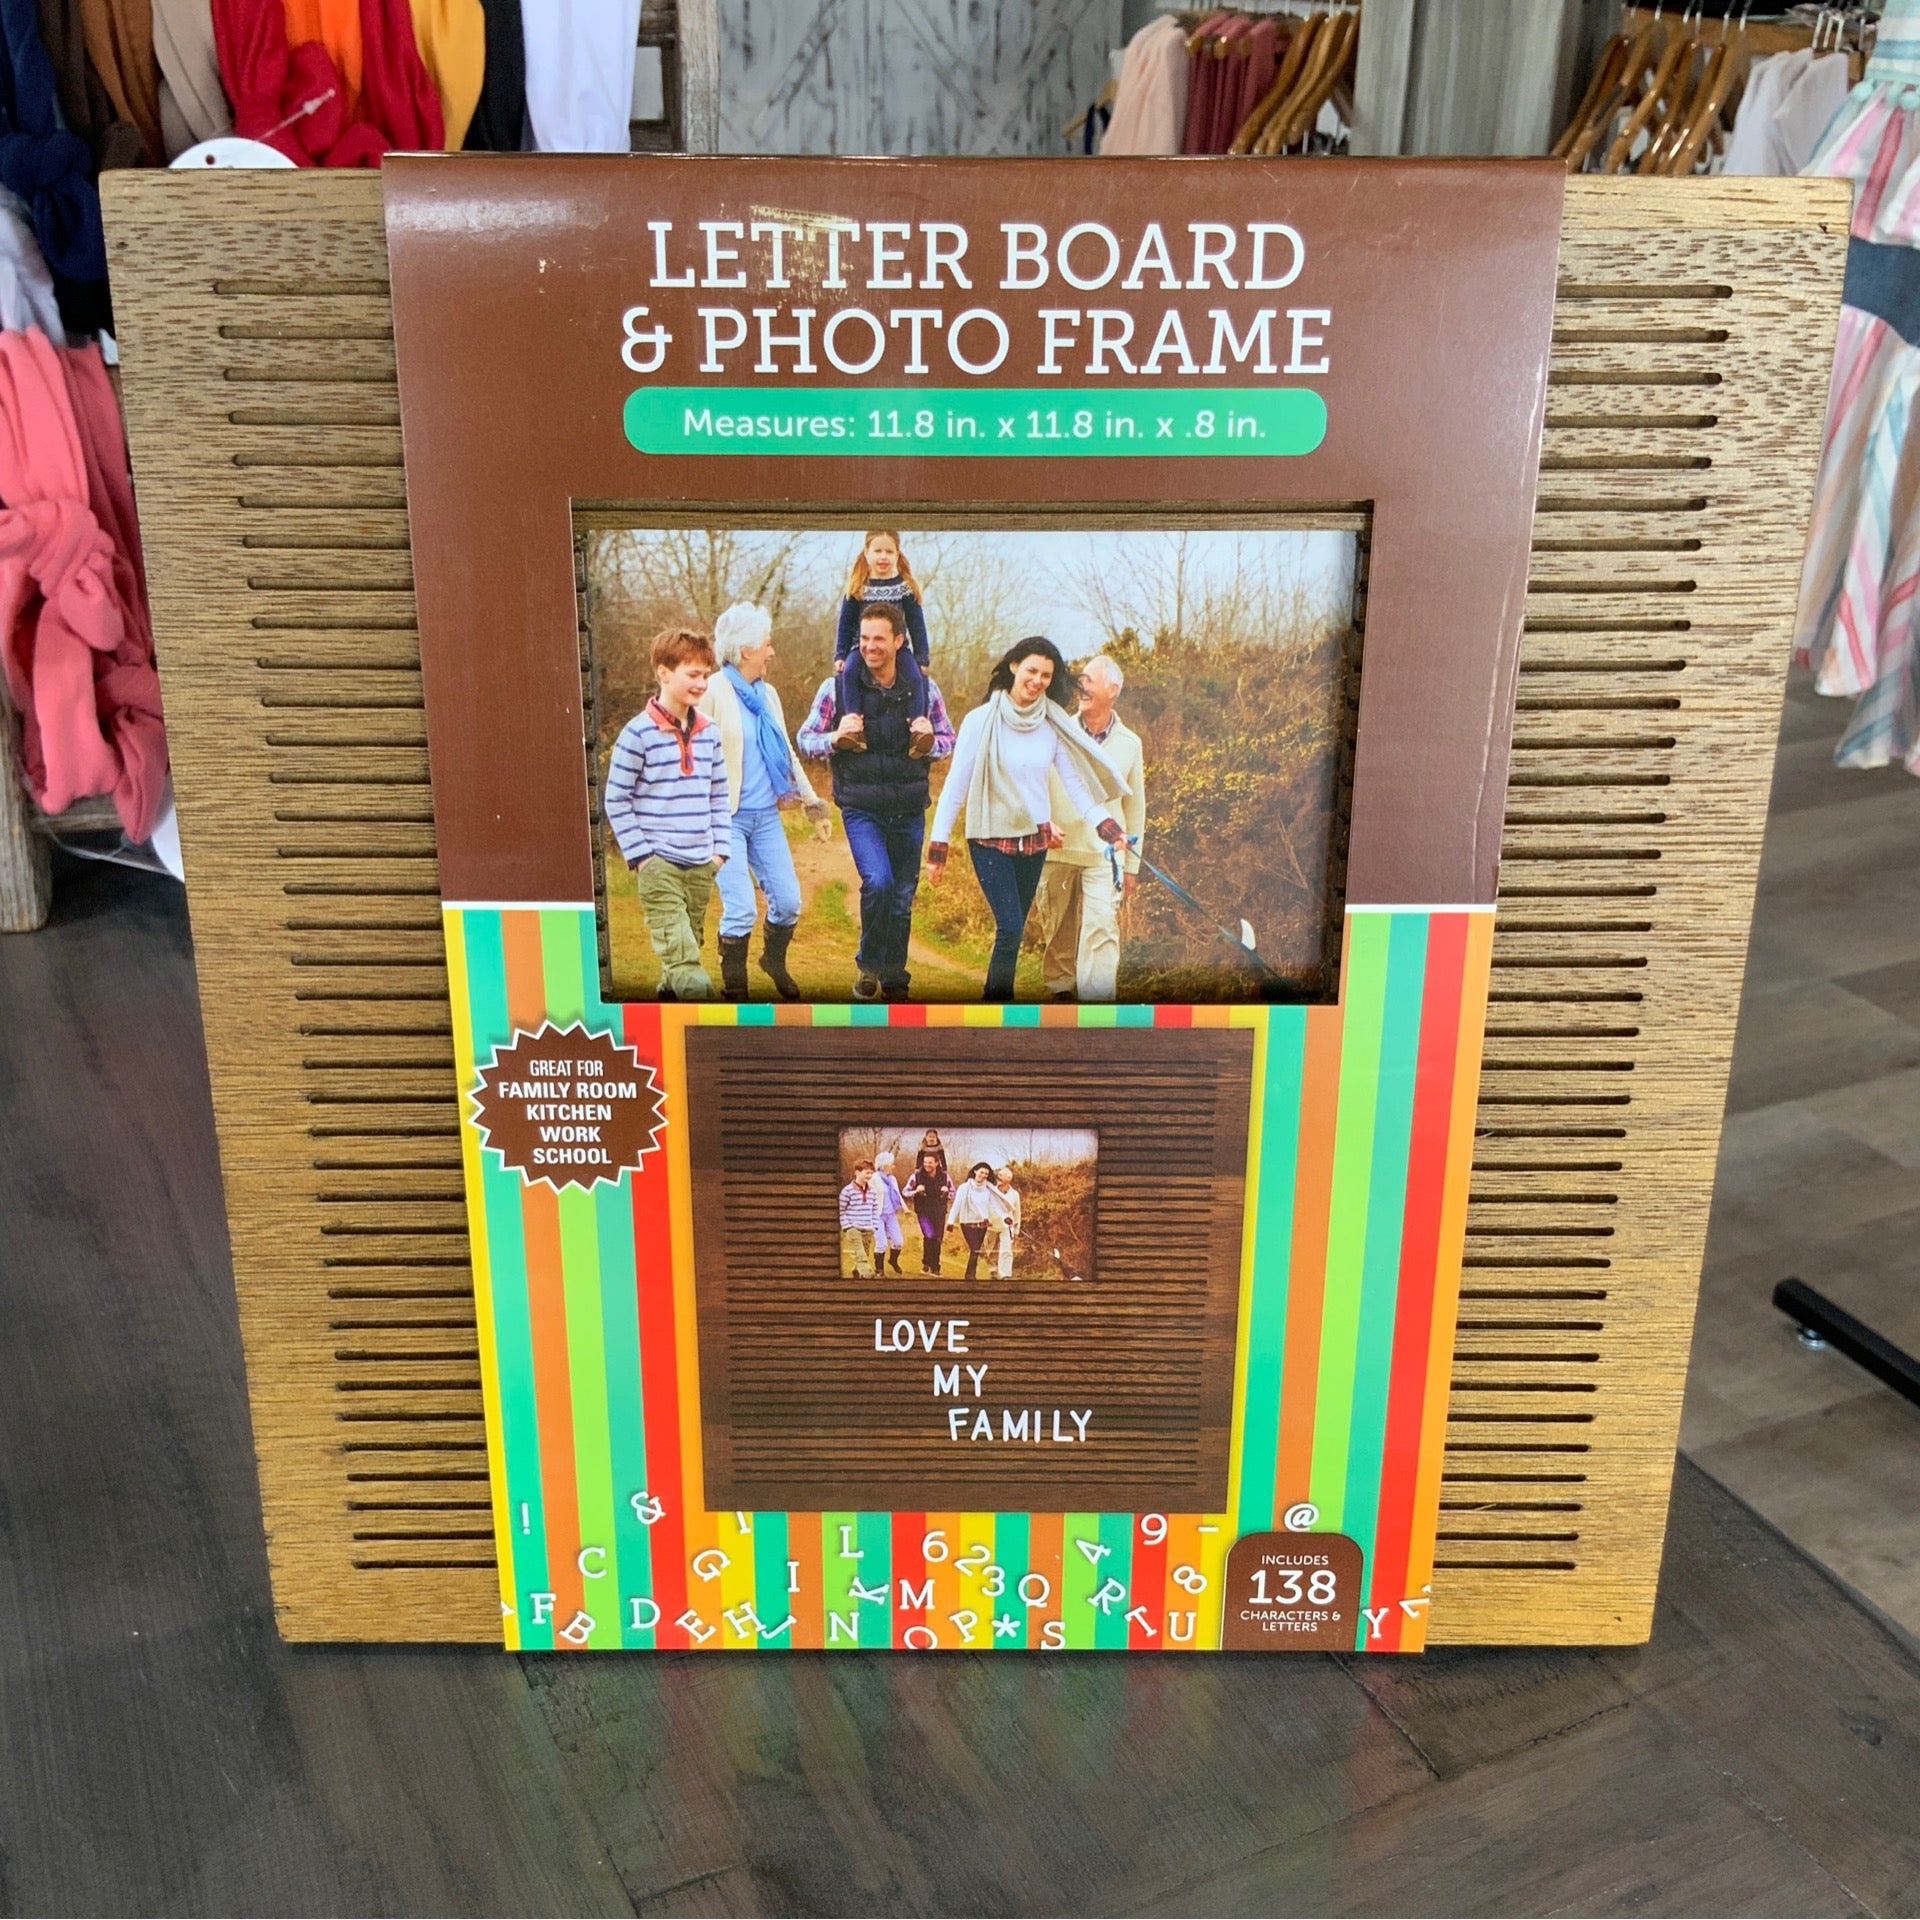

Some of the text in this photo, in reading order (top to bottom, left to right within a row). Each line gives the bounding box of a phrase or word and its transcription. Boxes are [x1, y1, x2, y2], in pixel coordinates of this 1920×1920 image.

[647, 221, 1305, 291] LETTER BOARD
[620, 307, 1331, 375] & PHOTO FRAME
[683, 409, 1266, 439] Measures: 11.8 in. x 11.8 in. x .8 in.
[530, 1060, 604, 1077] GREAT FOR
[499, 1082, 637, 1099] FAMILY ROOM
[526, 1104, 612, 1121] KITCHEN
[540, 1126, 602, 1143] WORK
[533, 1148, 612, 1164] SCHOOL
[875, 1318, 970, 1352] LOVE
[933, 1364, 988, 1397] MY
[948, 1407, 1093, 1443] FAMILY
[520, 1502, 531, 1535] !
[630, 1491, 666, 1525] &
[1284, 1503, 1320, 1532] @
[839, 1525, 864, 1558] L
[1140, 1513, 1168, 1546] 9
[577, 1546, 607, 1579] C
[922, 1530, 949, 1563] 6
[954, 1544, 990, 1577] 2
[1075, 1538, 1112, 1566] 4
[1261, 1554, 1330, 1566] INCLUDES
[692, 1549, 731, 1582] G
[786, 1560, 801, 1593] I
[981, 1565, 1006, 1597] 3
[1172, 1565, 1208, 1595] 8
[849, 1576, 890, 1606] K
[899, 1579, 935, 1610] M
[1017, 1573, 1051, 1608] Q
[1087, 1577, 1127, 1616] R
[1248, 1569, 1338, 1605] 138
[529, 1592, 556, 1625] F
[629, 1597, 661, 1629] D
[723, 1601, 766, 1639] H
[1124, 1605, 1158, 1638] T
[1239, 1609, 1329, 1622] CHARACTERS
[1362, 1607, 1390, 1639] Y
[559, 1611, 597, 1644] B
[674, 1609, 717, 1644] E
[828, 1611, 860, 1642] N
[949, 1610, 978, 1643] P
[1040, 1621, 1066, 1650] S
[1168, 1611, 1197, 1641] U
[1262, 1621, 1319, 1632] LETTERS
